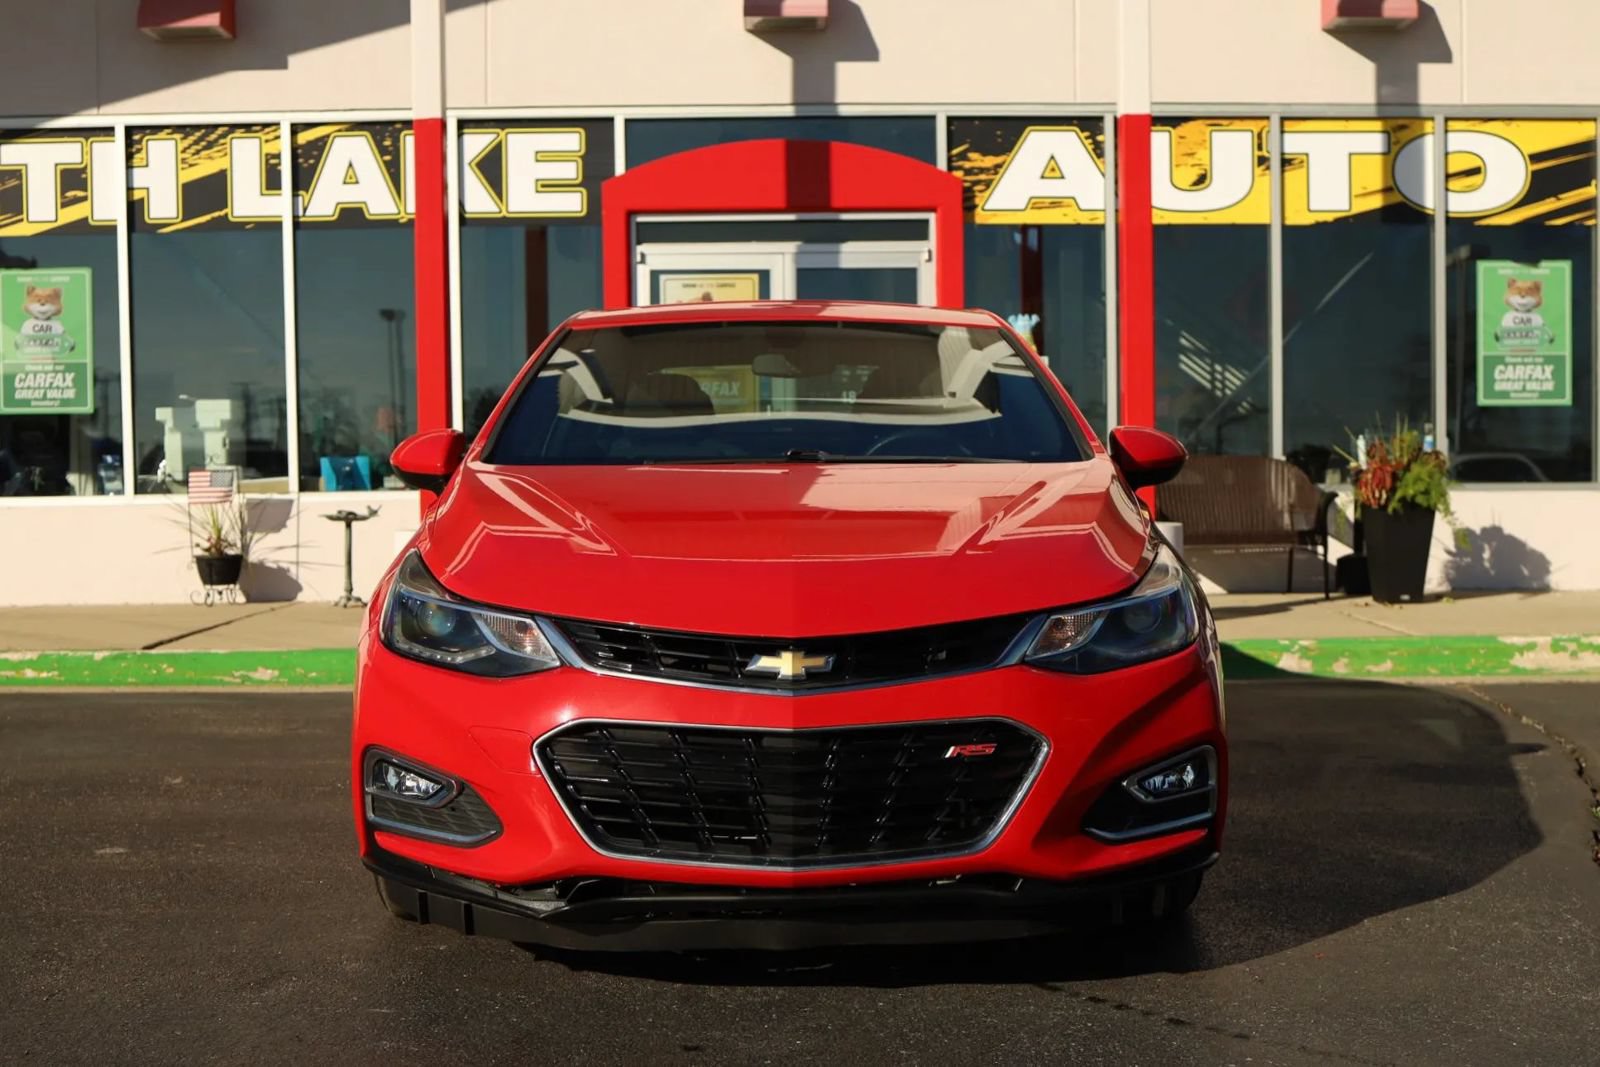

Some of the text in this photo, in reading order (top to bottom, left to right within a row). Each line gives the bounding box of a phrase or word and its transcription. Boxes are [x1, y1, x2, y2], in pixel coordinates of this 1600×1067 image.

[228, 129, 587, 221] LAKE
[980, 125, 1531, 217] AUTO
[32, 324, 52, 333] CAR
[14, 372, 75, 388] CARFAX
[1494, 364, 1554, 380] CARFAX
[14, 388, 76, 399] GREAT VALUE
[700, 381, 741, 397] RFAX
[945, 744, 997, 758] RS
